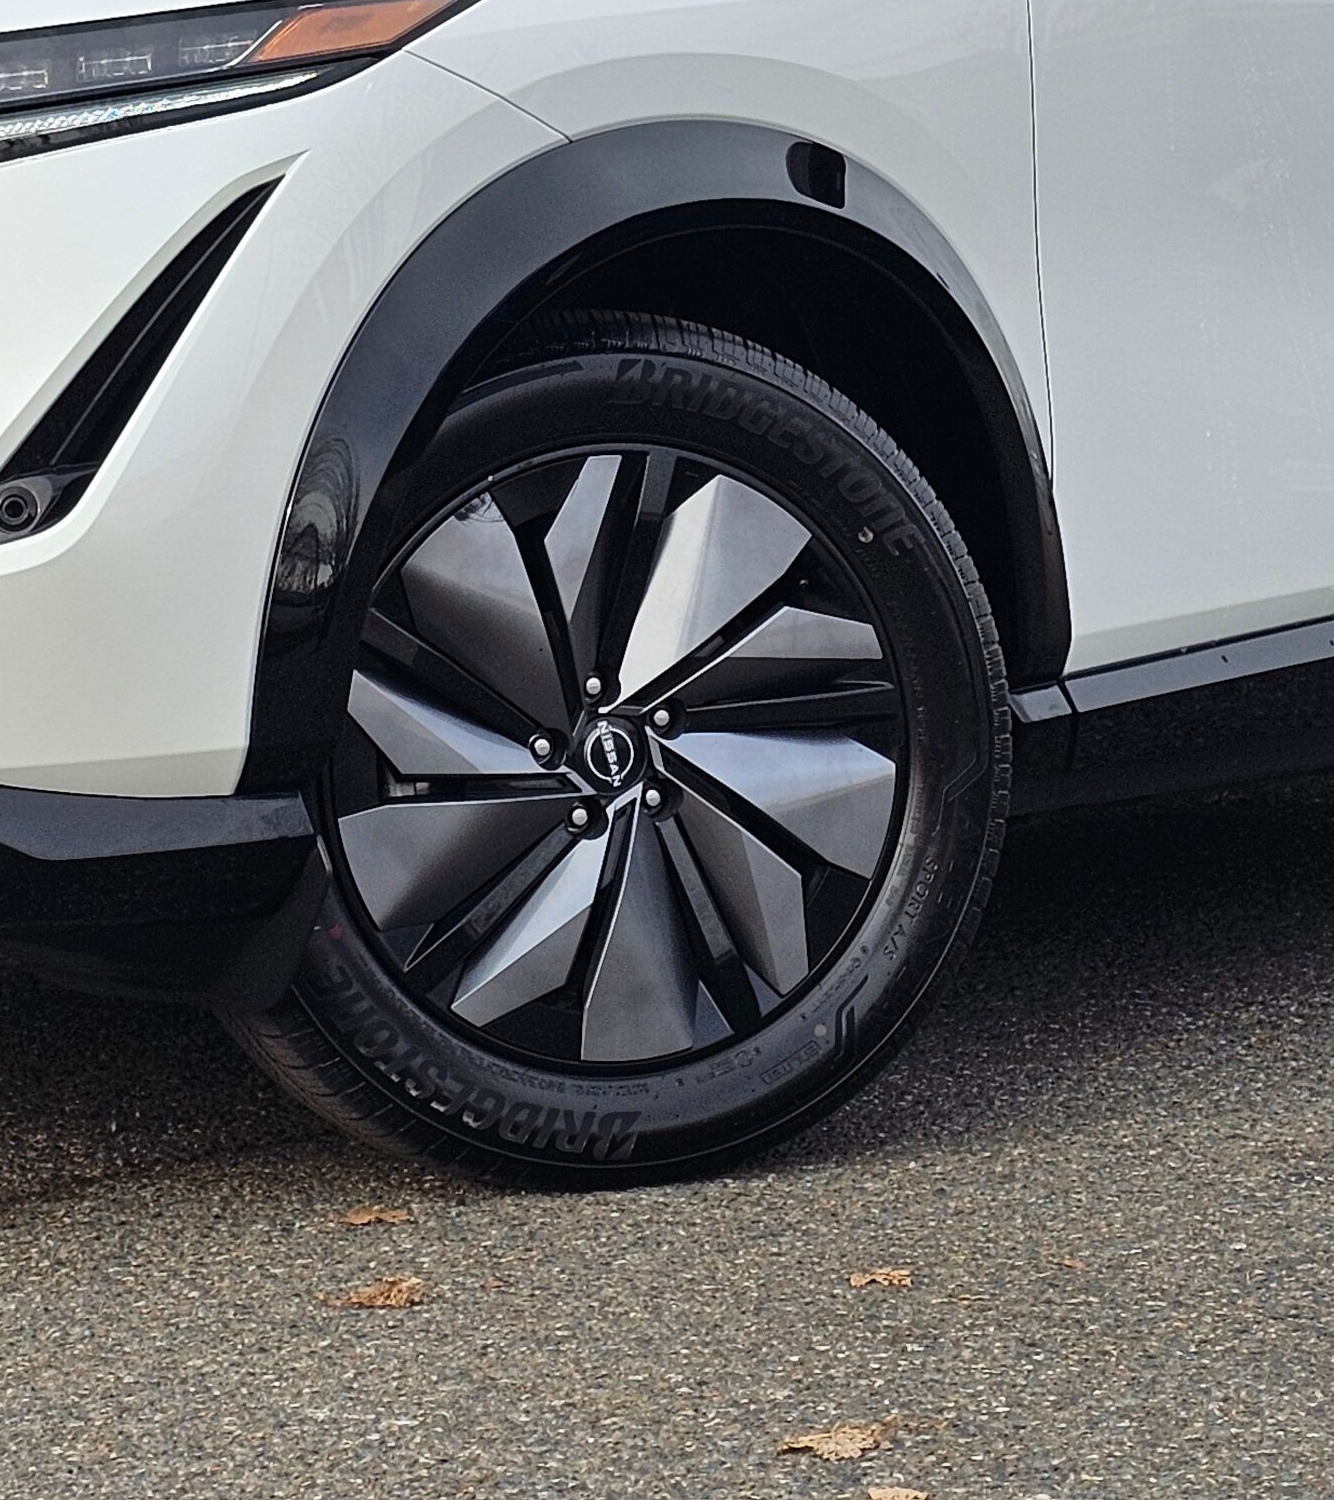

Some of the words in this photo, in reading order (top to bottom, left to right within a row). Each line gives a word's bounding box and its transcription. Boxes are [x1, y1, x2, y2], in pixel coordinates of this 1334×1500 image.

[596, 720, 622, 788] NISSAN
[903, 855, 940, 926] SPORT
[882, 923, 907, 961] A/S
[309, 964, 643, 1161] BRIDGESTONE
